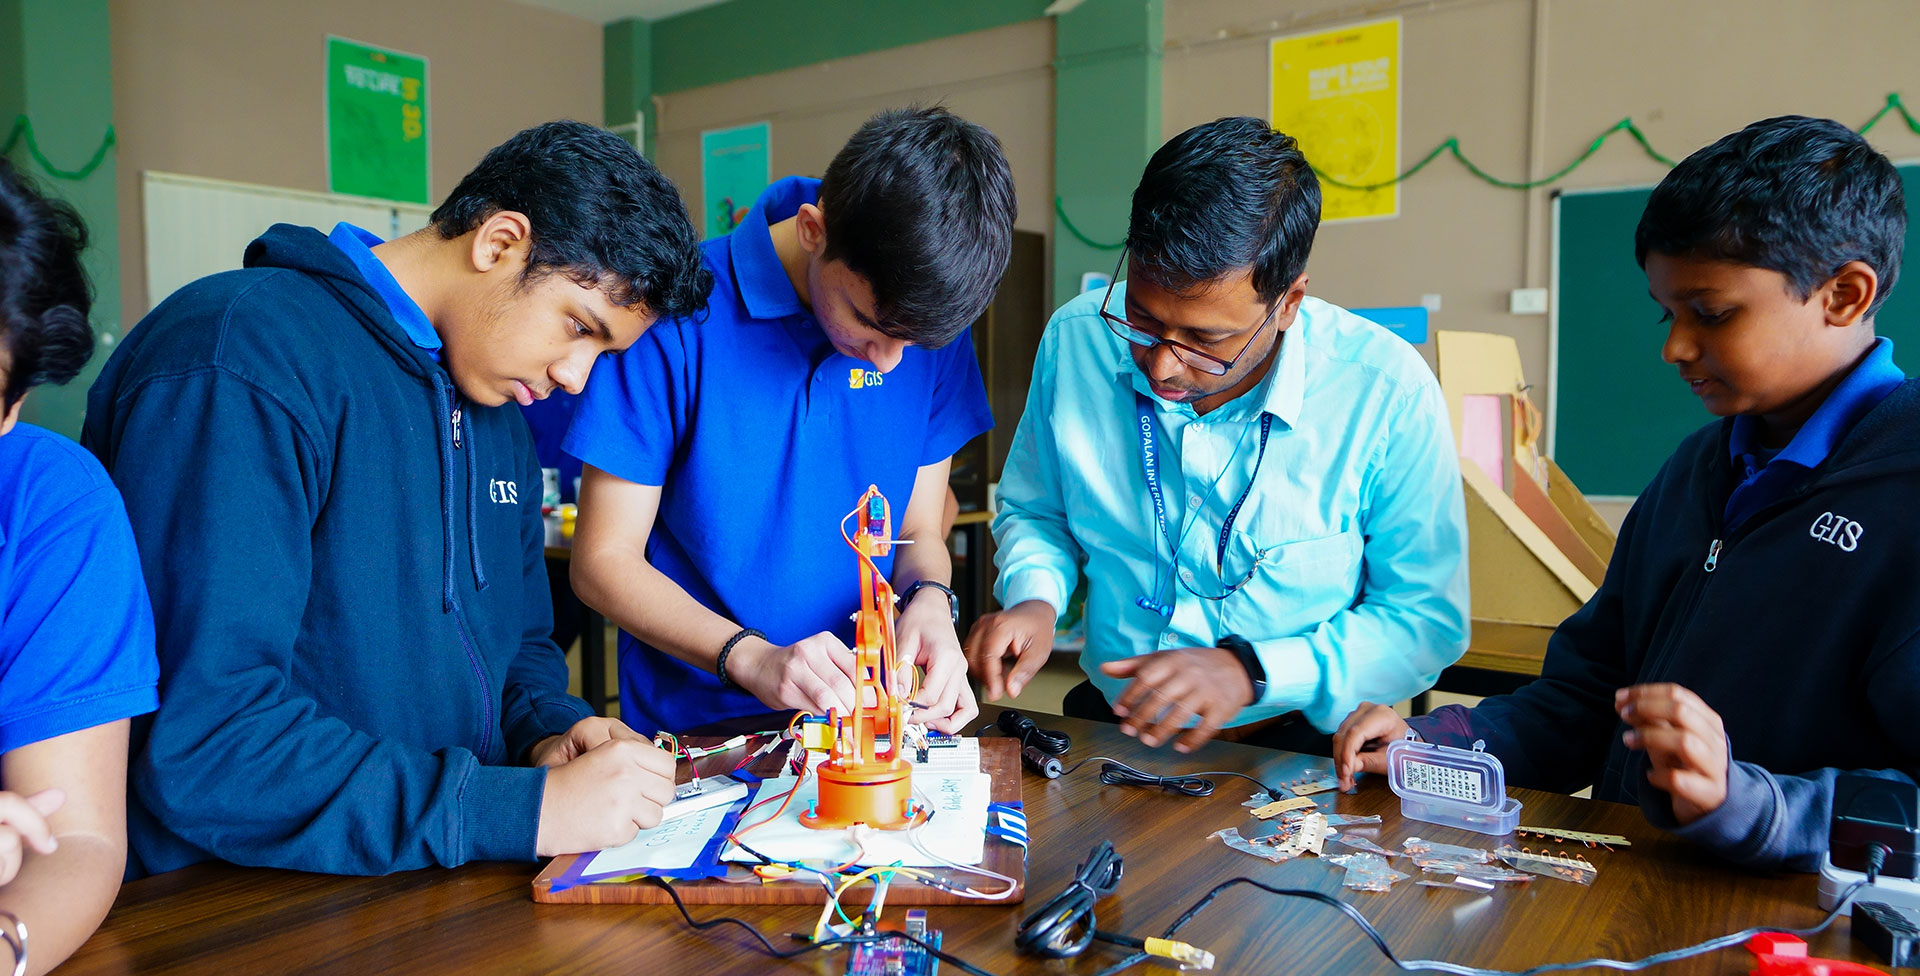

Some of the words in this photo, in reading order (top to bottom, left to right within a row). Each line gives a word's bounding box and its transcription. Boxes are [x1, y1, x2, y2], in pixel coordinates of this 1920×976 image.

[864, 370, 883, 387] GIS
[1141, 415, 1155, 467] GOPALAN
[489, 478, 518, 504] GIS
[1809, 511, 1864, 552] GIS
